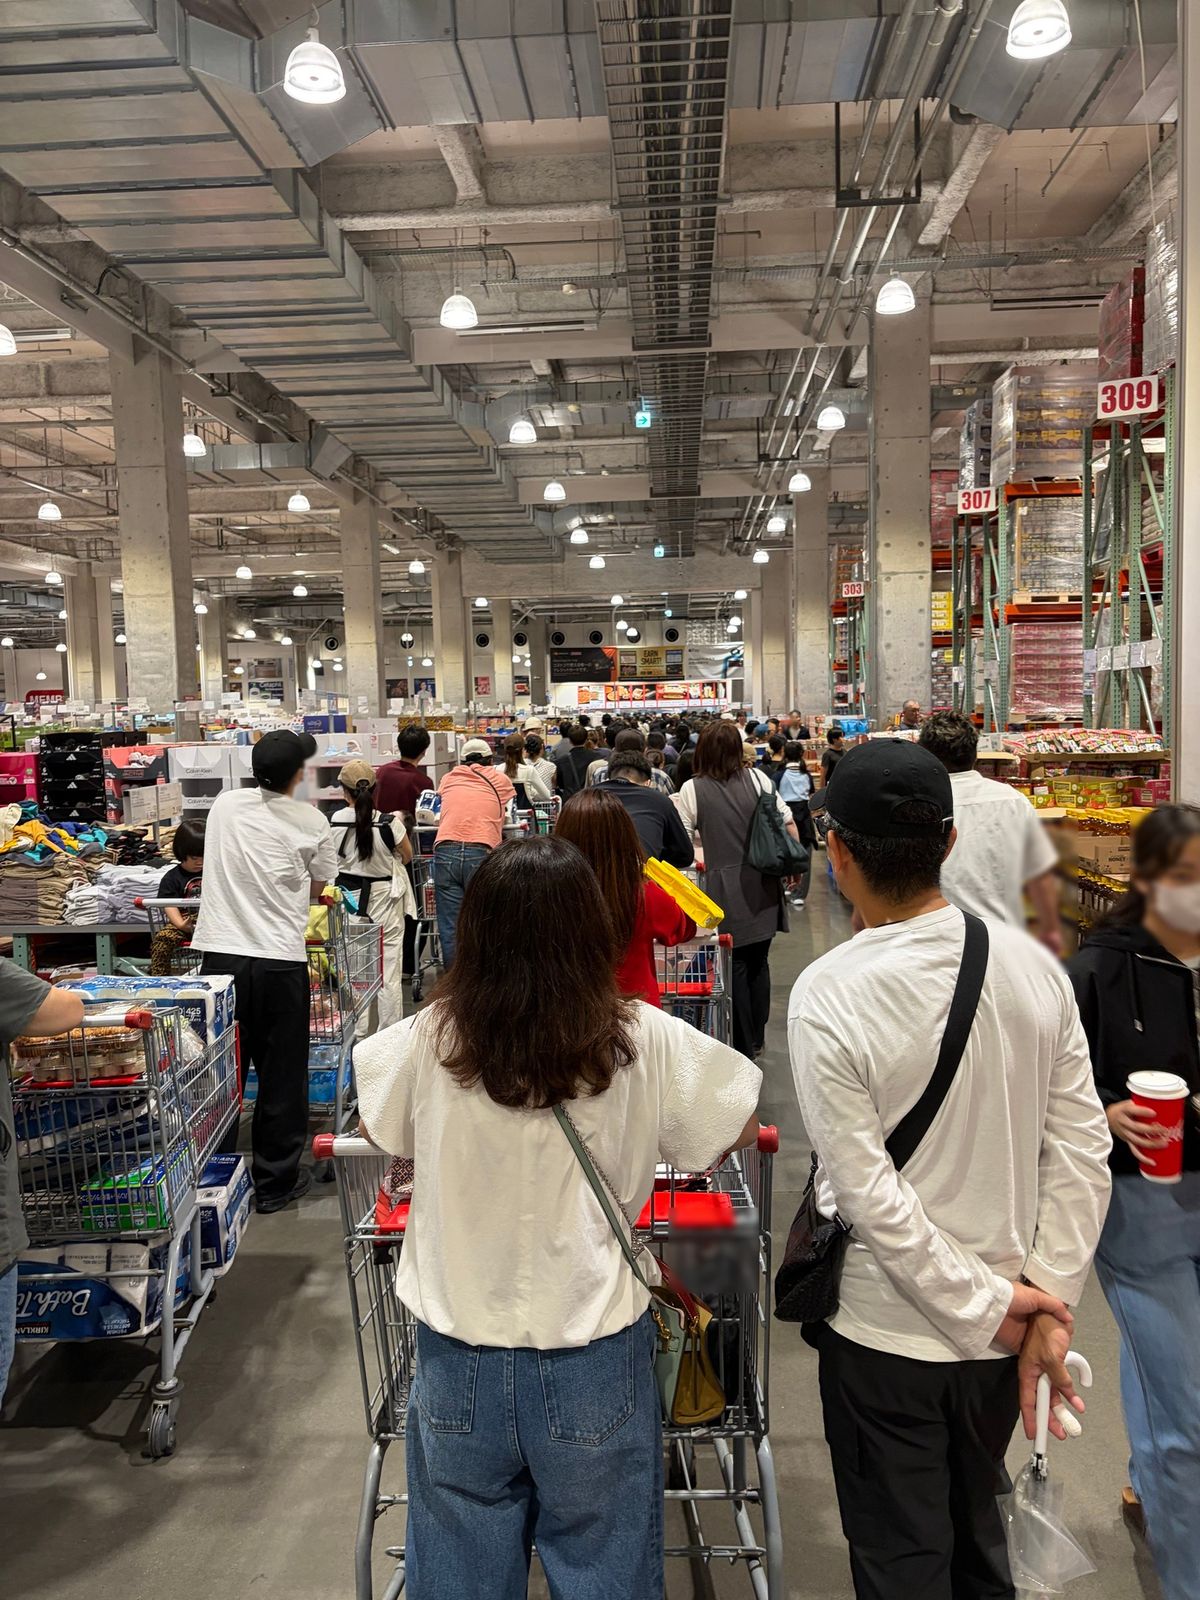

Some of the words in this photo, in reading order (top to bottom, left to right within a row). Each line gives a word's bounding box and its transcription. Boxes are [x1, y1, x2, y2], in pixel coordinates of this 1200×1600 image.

[1100, 383, 1153, 413] 309
[961, 489, 992, 511] 307
[843, 583, 862, 595] 303
[643, 649, 659, 657] EARN
[185, 1007, 201, 1015] 425
[34, 1289, 91, 1316] Bath
